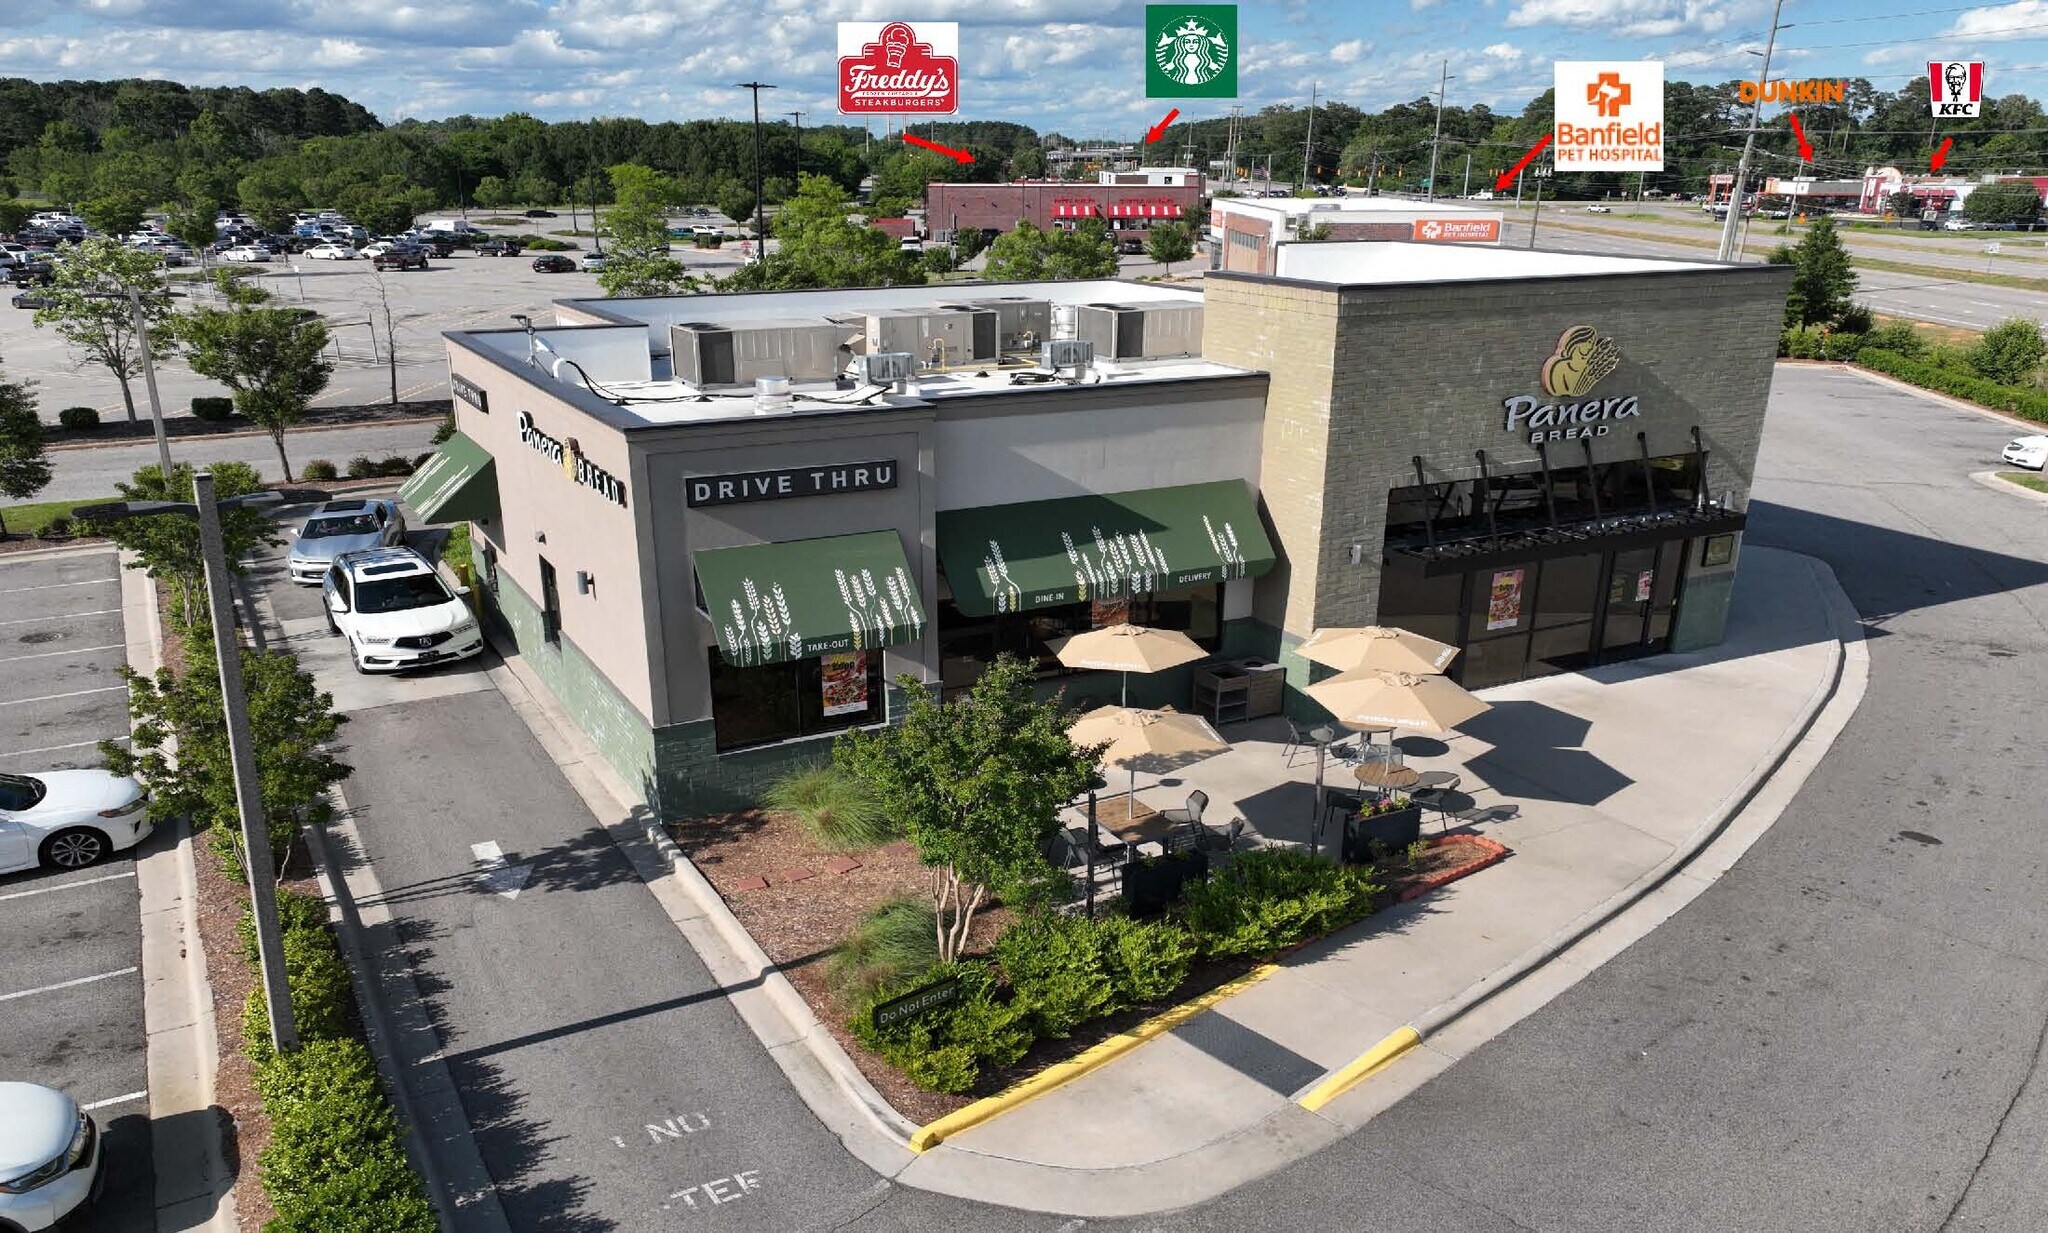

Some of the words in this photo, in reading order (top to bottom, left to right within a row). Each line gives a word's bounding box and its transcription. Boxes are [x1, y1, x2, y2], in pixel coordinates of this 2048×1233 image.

[1444, 222, 1491, 232] Banfield
[1503, 394, 1642, 433] Panera
[1530, 425, 1610, 444] BREAD
[515, 410, 565, 469] Panera
[577, 457, 622, 506] BREAD
[694, 475, 793, 501] DRIVE
[810, 466, 891, 490] THRU
[1178, 571, 1212, 584] DELIVERY
[1034, 592, 1065, 604] DINE-IN
[807, 639, 850, 652] TAKE-OUT
[880, 1012, 896, 1024] Do
[899, 1000, 920, 1016] Not
[922, 986, 955, 1006] Enter
